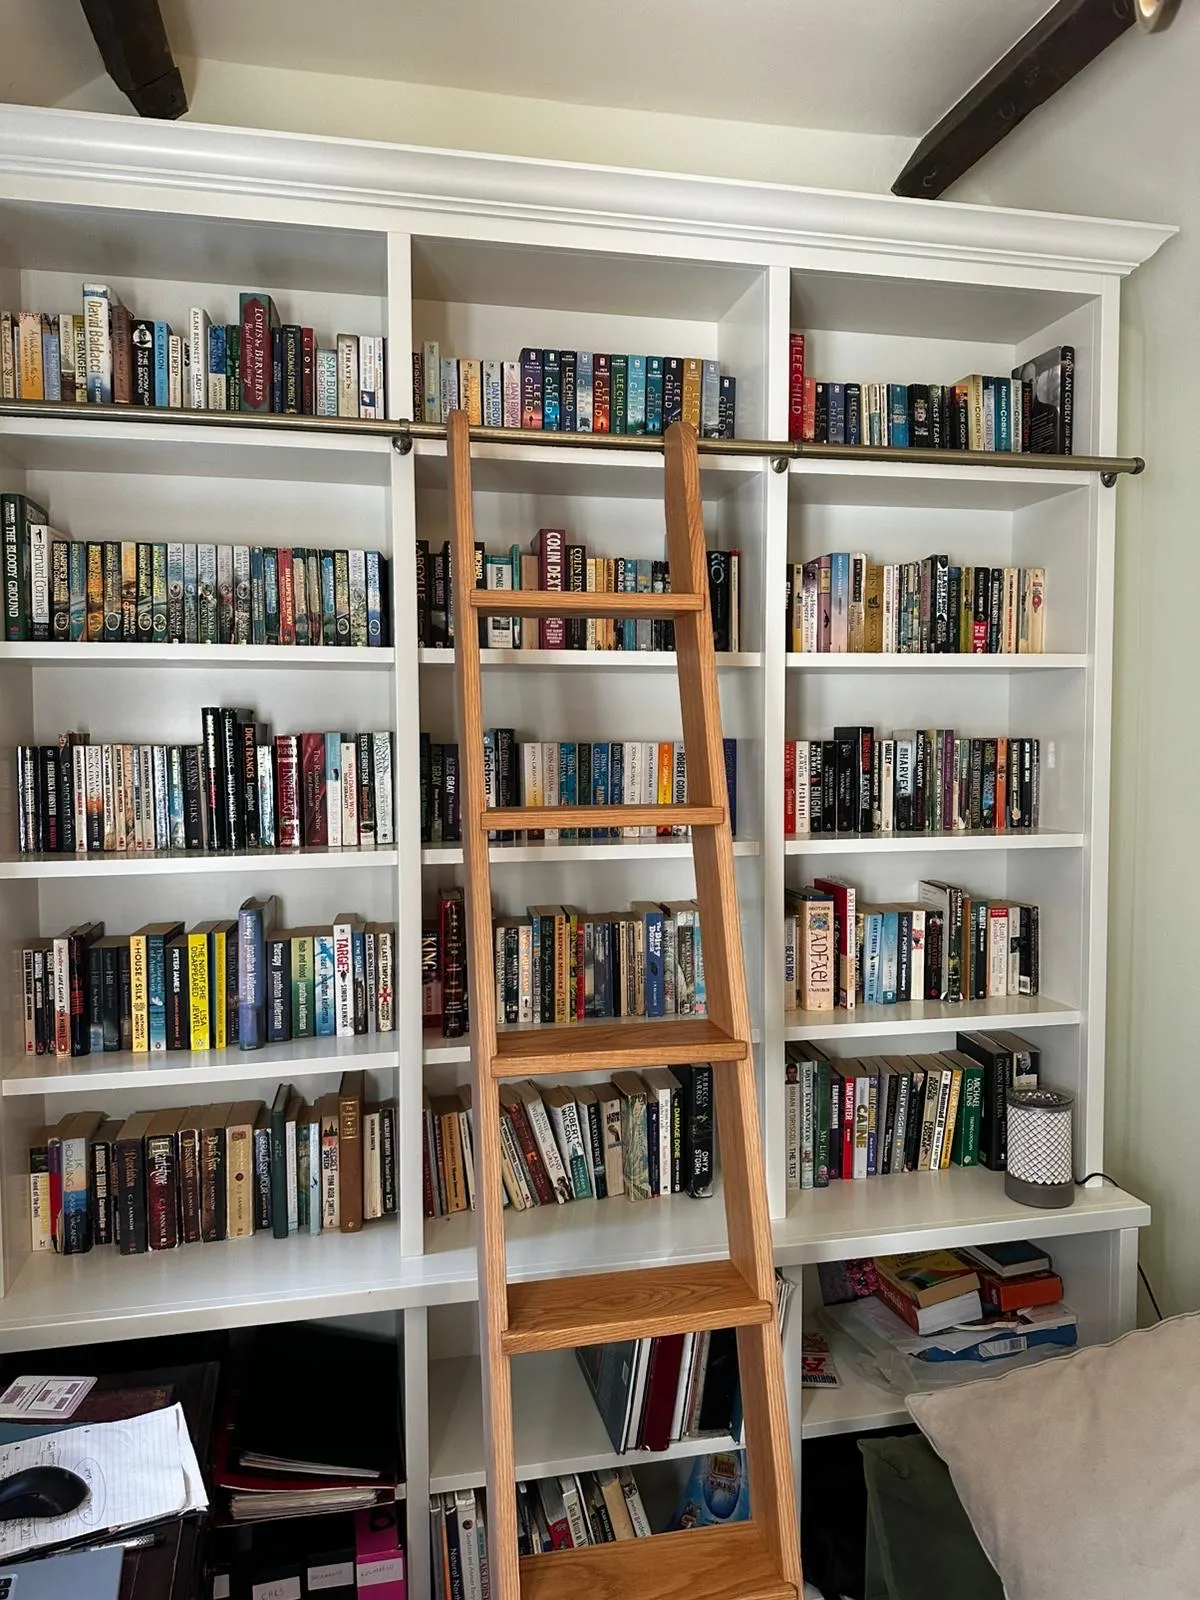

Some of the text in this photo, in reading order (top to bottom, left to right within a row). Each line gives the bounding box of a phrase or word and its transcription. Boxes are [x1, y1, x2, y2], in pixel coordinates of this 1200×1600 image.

[87, 301, 105, 374] David Baldacci
[253, 308, 264, 337] LOUIS
[76, 340, 87, 378] RANGER
[171, 355, 181, 377] DEEP
[325, 356, 335, 378] SAM
[491, 382, 499, 399] DAN
[510, 382, 519, 400] DAN
[525, 377, 533, 413] CHILD
[566, 367, 574, 412] LEE CHILD
[792, 347, 801, 414] LEE CHILD
[1064, 392, 1072, 423] COBEN
[6, 526, 19, 618] THE BLOODY GROUND
[546, 532, 561, 592] COLIN DEXT
[34, 544, 47, 618] Bernard Cornwell
[495, 567, 504, 588] MICHAEL
[360, 735, 368, 750] TESS
[47, 761, 56, 791] FREDERICK
[244, 728, 255, 812] DICK FRANCIS Longshot
[360, 751, 369, 785] GERRITSEN
[432, 766, 441, 785] GRAY
[567, 754, 575, 775] JOHN
[676, 752, 685, 804] ROBERT GODDA
[899, 754, 909, 791] HARVEY
[446, 775, 455, 794] GRAY
[189, 799, 198, 823] SILKS
[811, 786, 820, 818] ENIGMA
[299, 953, 307, 963] and
[337, 938, 349, 974] TARGET
[422, 937, 437, 970] KING
[654, 932, 662, 957] Dirty
[191, 946, 199, 998] DISAPPEARED
[243, 916, 256, 1004] therapy jonathan kellerman
[299, 964, 308, 978] blood
[381, 962, 389, 988] TEMPLAR
[785, 946, 794, 982] BEACH ROAD
[271, 943, 283, 1029] therapy jonathan kellerman
[192, 1003, 200, 1033] JEWELL
[199, 1009, 207, 1026] LISA
[296, 981, 309, 1030] jonathan kellerman
[926, 1076, 934, 1101] KICKS
[938, 1083, 950, 1119] Muhammad
[972, 1077, 981, 1108] MICHAEL
[845, 1096, 853, 1120] CARTER
[868, 1104, 876, 1133] CONNOLLY
[896, 1077, 908, 1136] BRADLEY WIGGINS
[561, 1107, 572, 1144] WILSON
[567, 1105, 582, 1140] ROBERT
[819, 1130, 827, 1143] My
[856, 1104, 867, 1148] CAINE
[921, 1120, 929, 1147] LOGAN
[926, 1121, 934, 1146] KENNY
[96, 1150, 106, 1172] BRIDGE
[150, 1141, 171, 1185] Heartstone
[259, 1136, 268, 1161] GERALD
[330, 1147, 338, 1172] SECRET
[550, 1151, 562, 1170] LAND
[65, 1143, 75, 1187] ROWLING
[96, 1173, 106, 1185] TOO
[327, 1174, 335, 1186] TOM
[97, 1185, 106, 1198] FAR
[33, 1205, 41, 1218] Devil
[328, 1200, 336, 1216] SMITH
[450, 1548, 460, 1578] Natural
